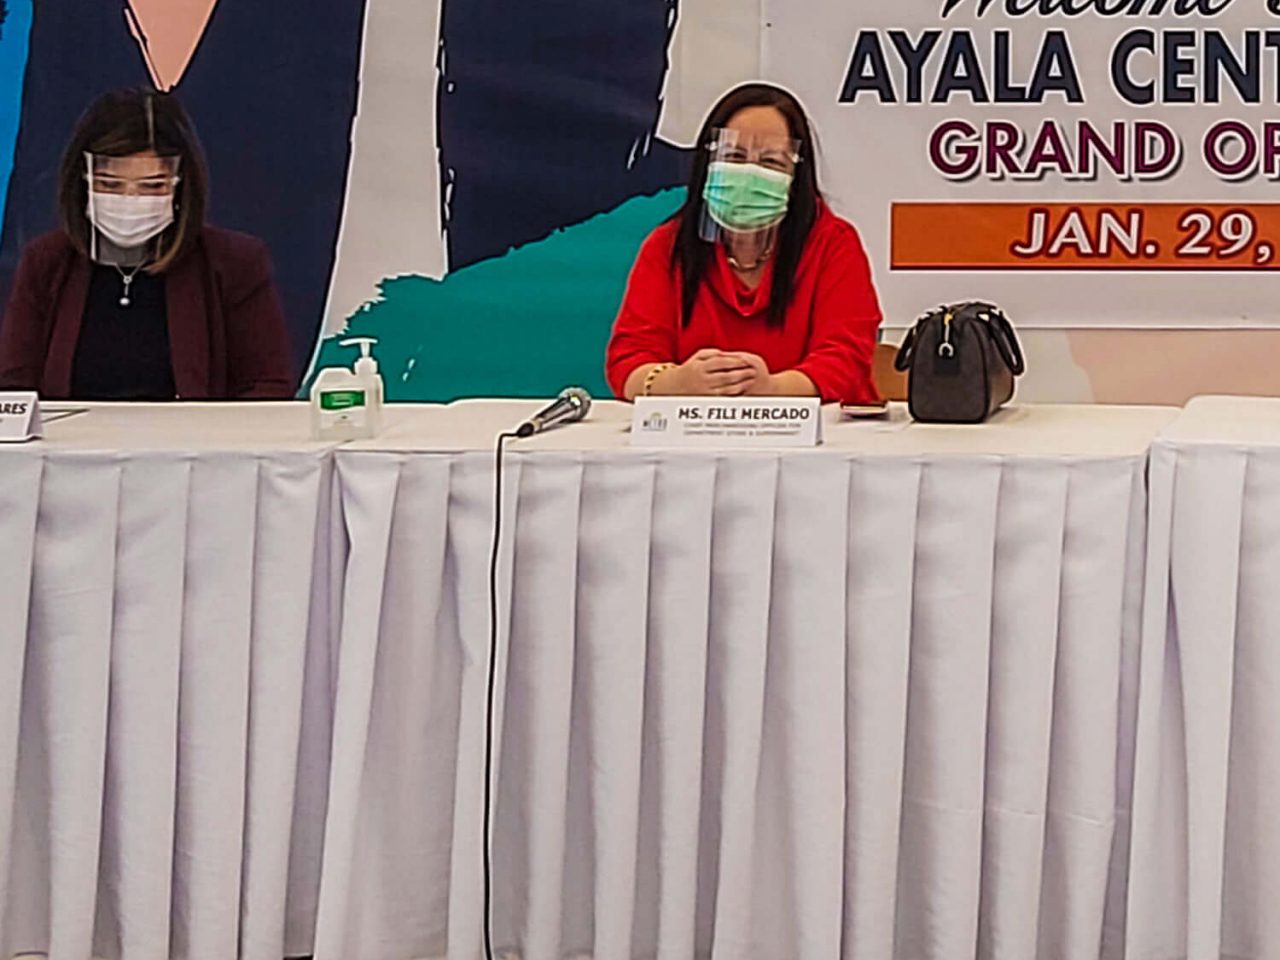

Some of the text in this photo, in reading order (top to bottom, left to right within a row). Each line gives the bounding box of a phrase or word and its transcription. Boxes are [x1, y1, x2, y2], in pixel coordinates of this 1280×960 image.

[838, 30, 1085, 104] AYALA
[928, 120, 1180, 178] GRAND
[1012, 211, 1158, 256] JAN.
[1176, 211, 1272, 263] 29,
[678, 407, 810, 420] MS. FILI MERCADO
